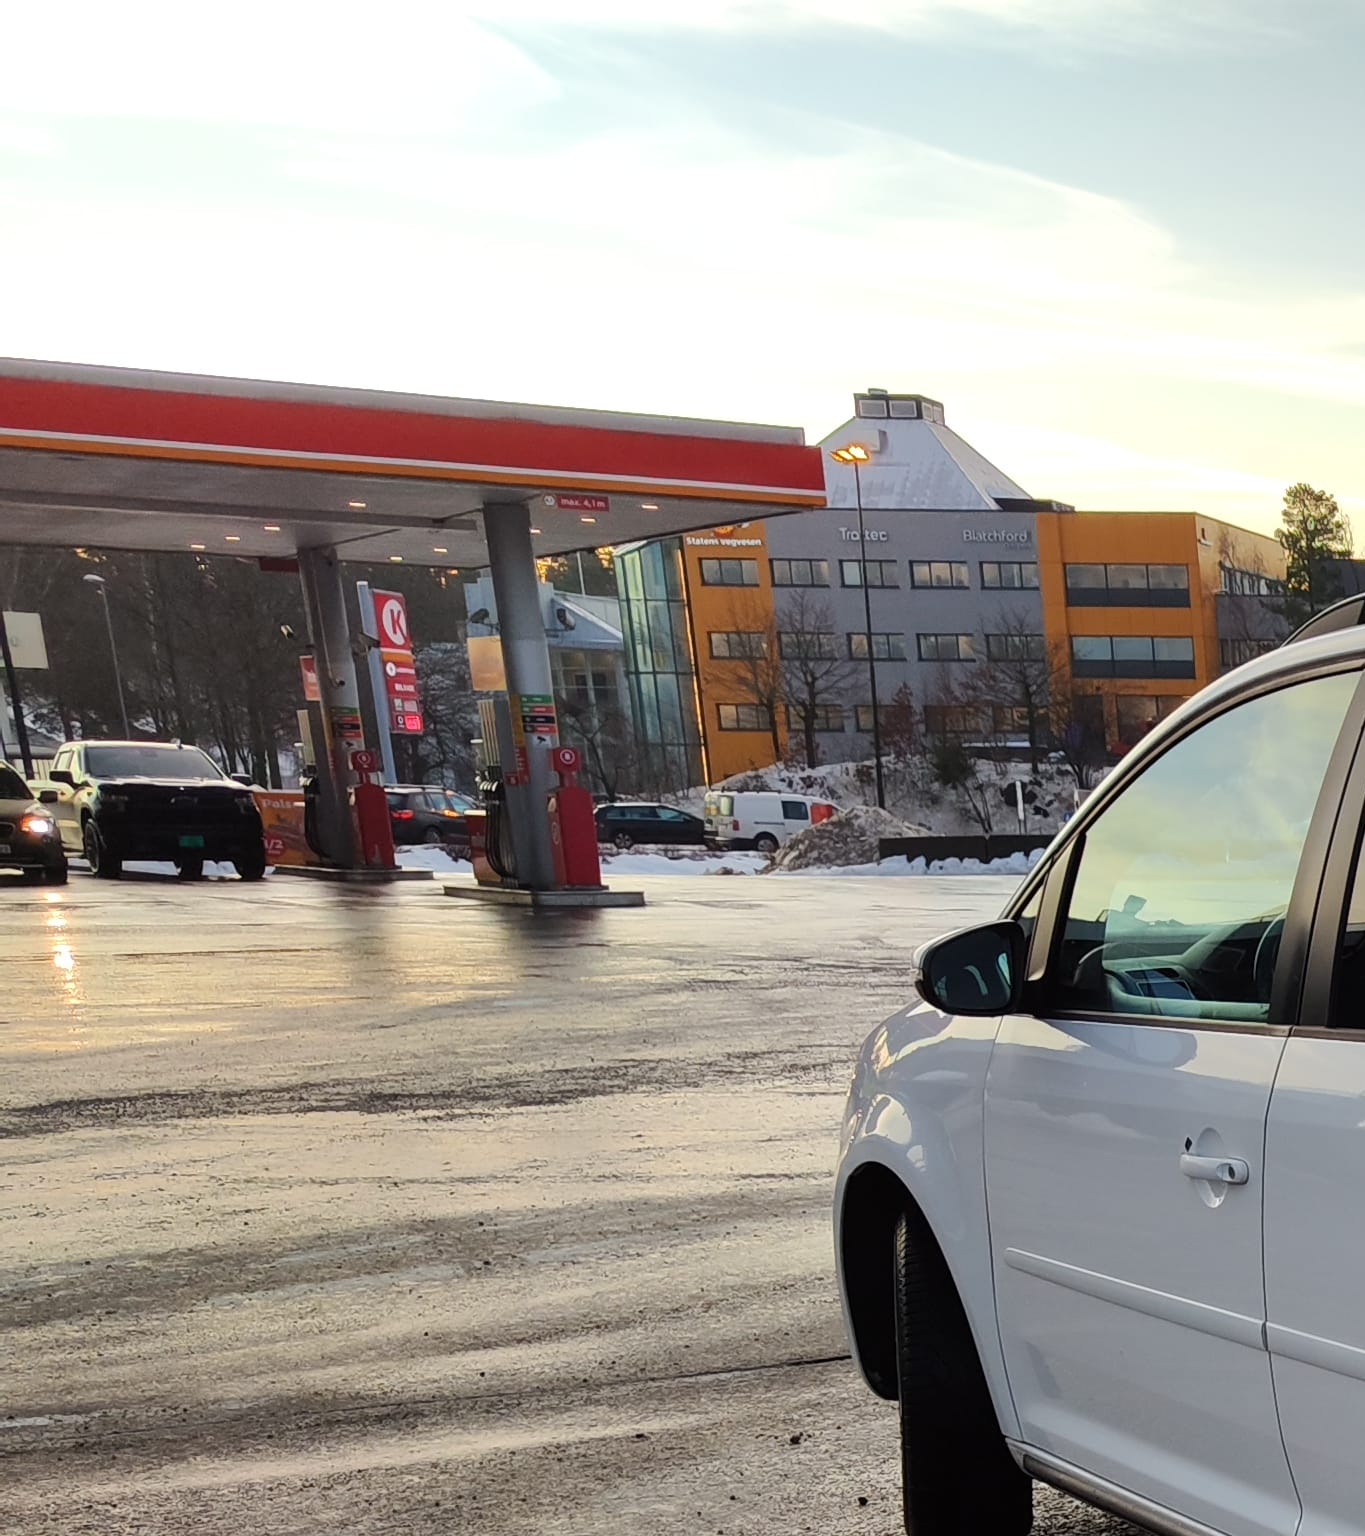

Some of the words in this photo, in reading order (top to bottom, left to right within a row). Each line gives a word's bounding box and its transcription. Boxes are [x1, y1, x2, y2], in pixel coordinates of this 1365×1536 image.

[838, 527, 888, 541] Tratec
[962, 529, 1028, 542] Blatchford
[686, 536, 720, 546] Statens
[720, 538, 762, 547] vegvesen
